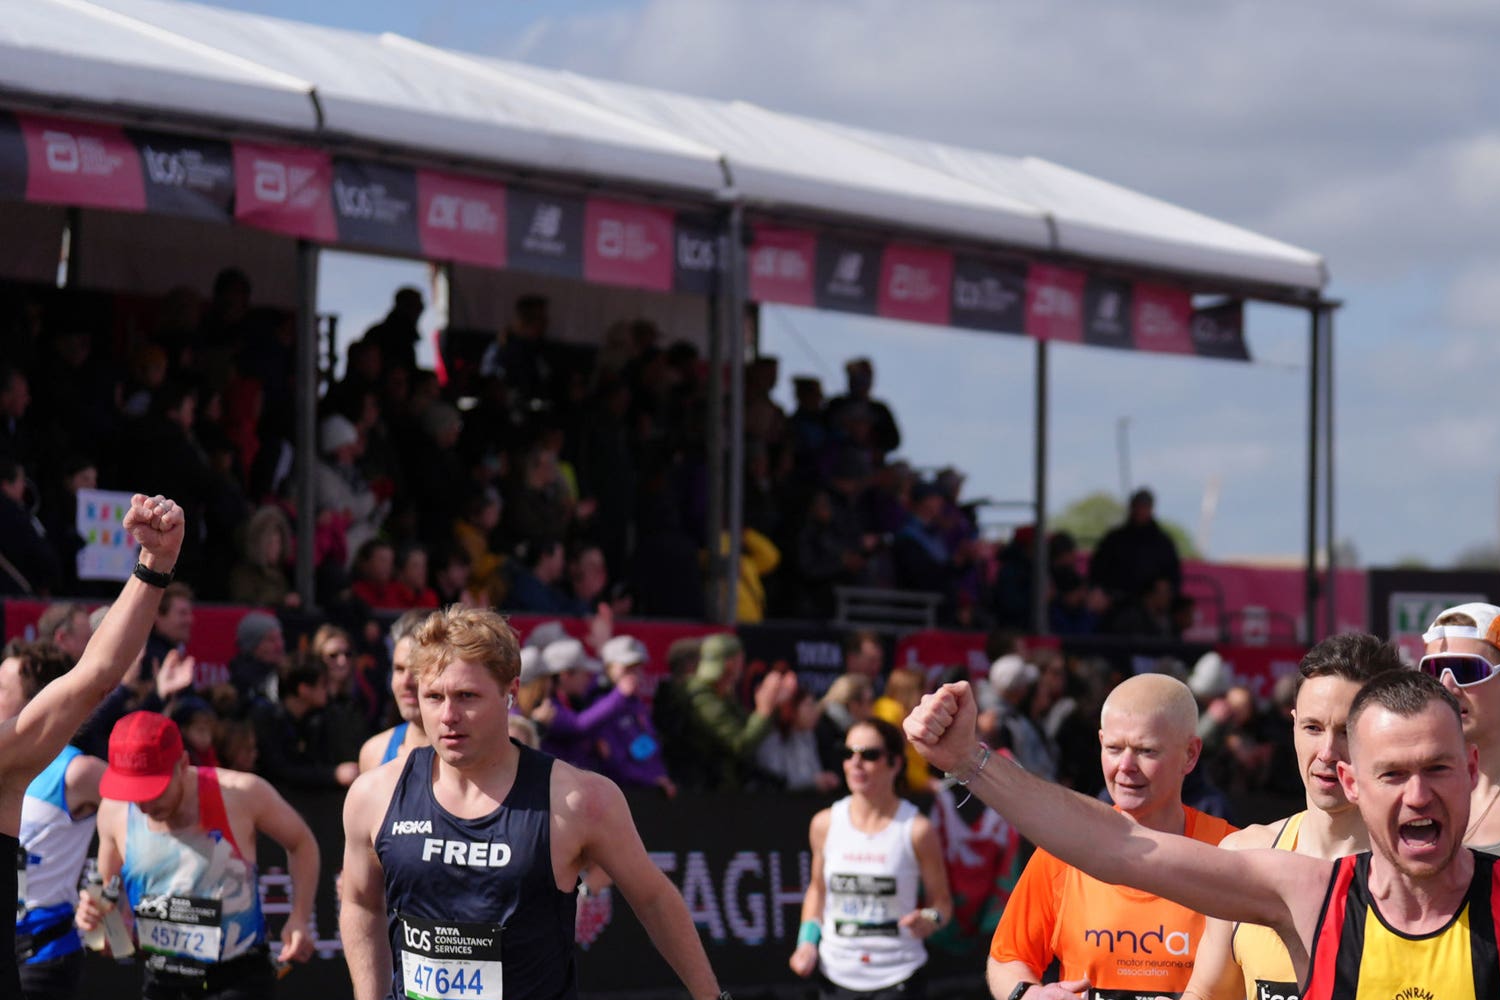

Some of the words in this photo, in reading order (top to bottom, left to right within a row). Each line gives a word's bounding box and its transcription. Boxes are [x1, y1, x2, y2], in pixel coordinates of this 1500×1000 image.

[392, 820, 433, 836] HOKA
[422, 838, 512, 867] FRED
[151, 925, 205, 952] 45772
[404, 919, 432, 951] tcs
[434, 926, 460, 936] TATA
[434, 936, 493, 947] CONSULTANCY
[1085, 924, 1190, 955] mnda
[434, 945, 472, 954] SERVICES
[1117, 959, 1143, 967] motor
[414, 963, 484, 995] 47644
[1117, 967, 1168, 976] association
